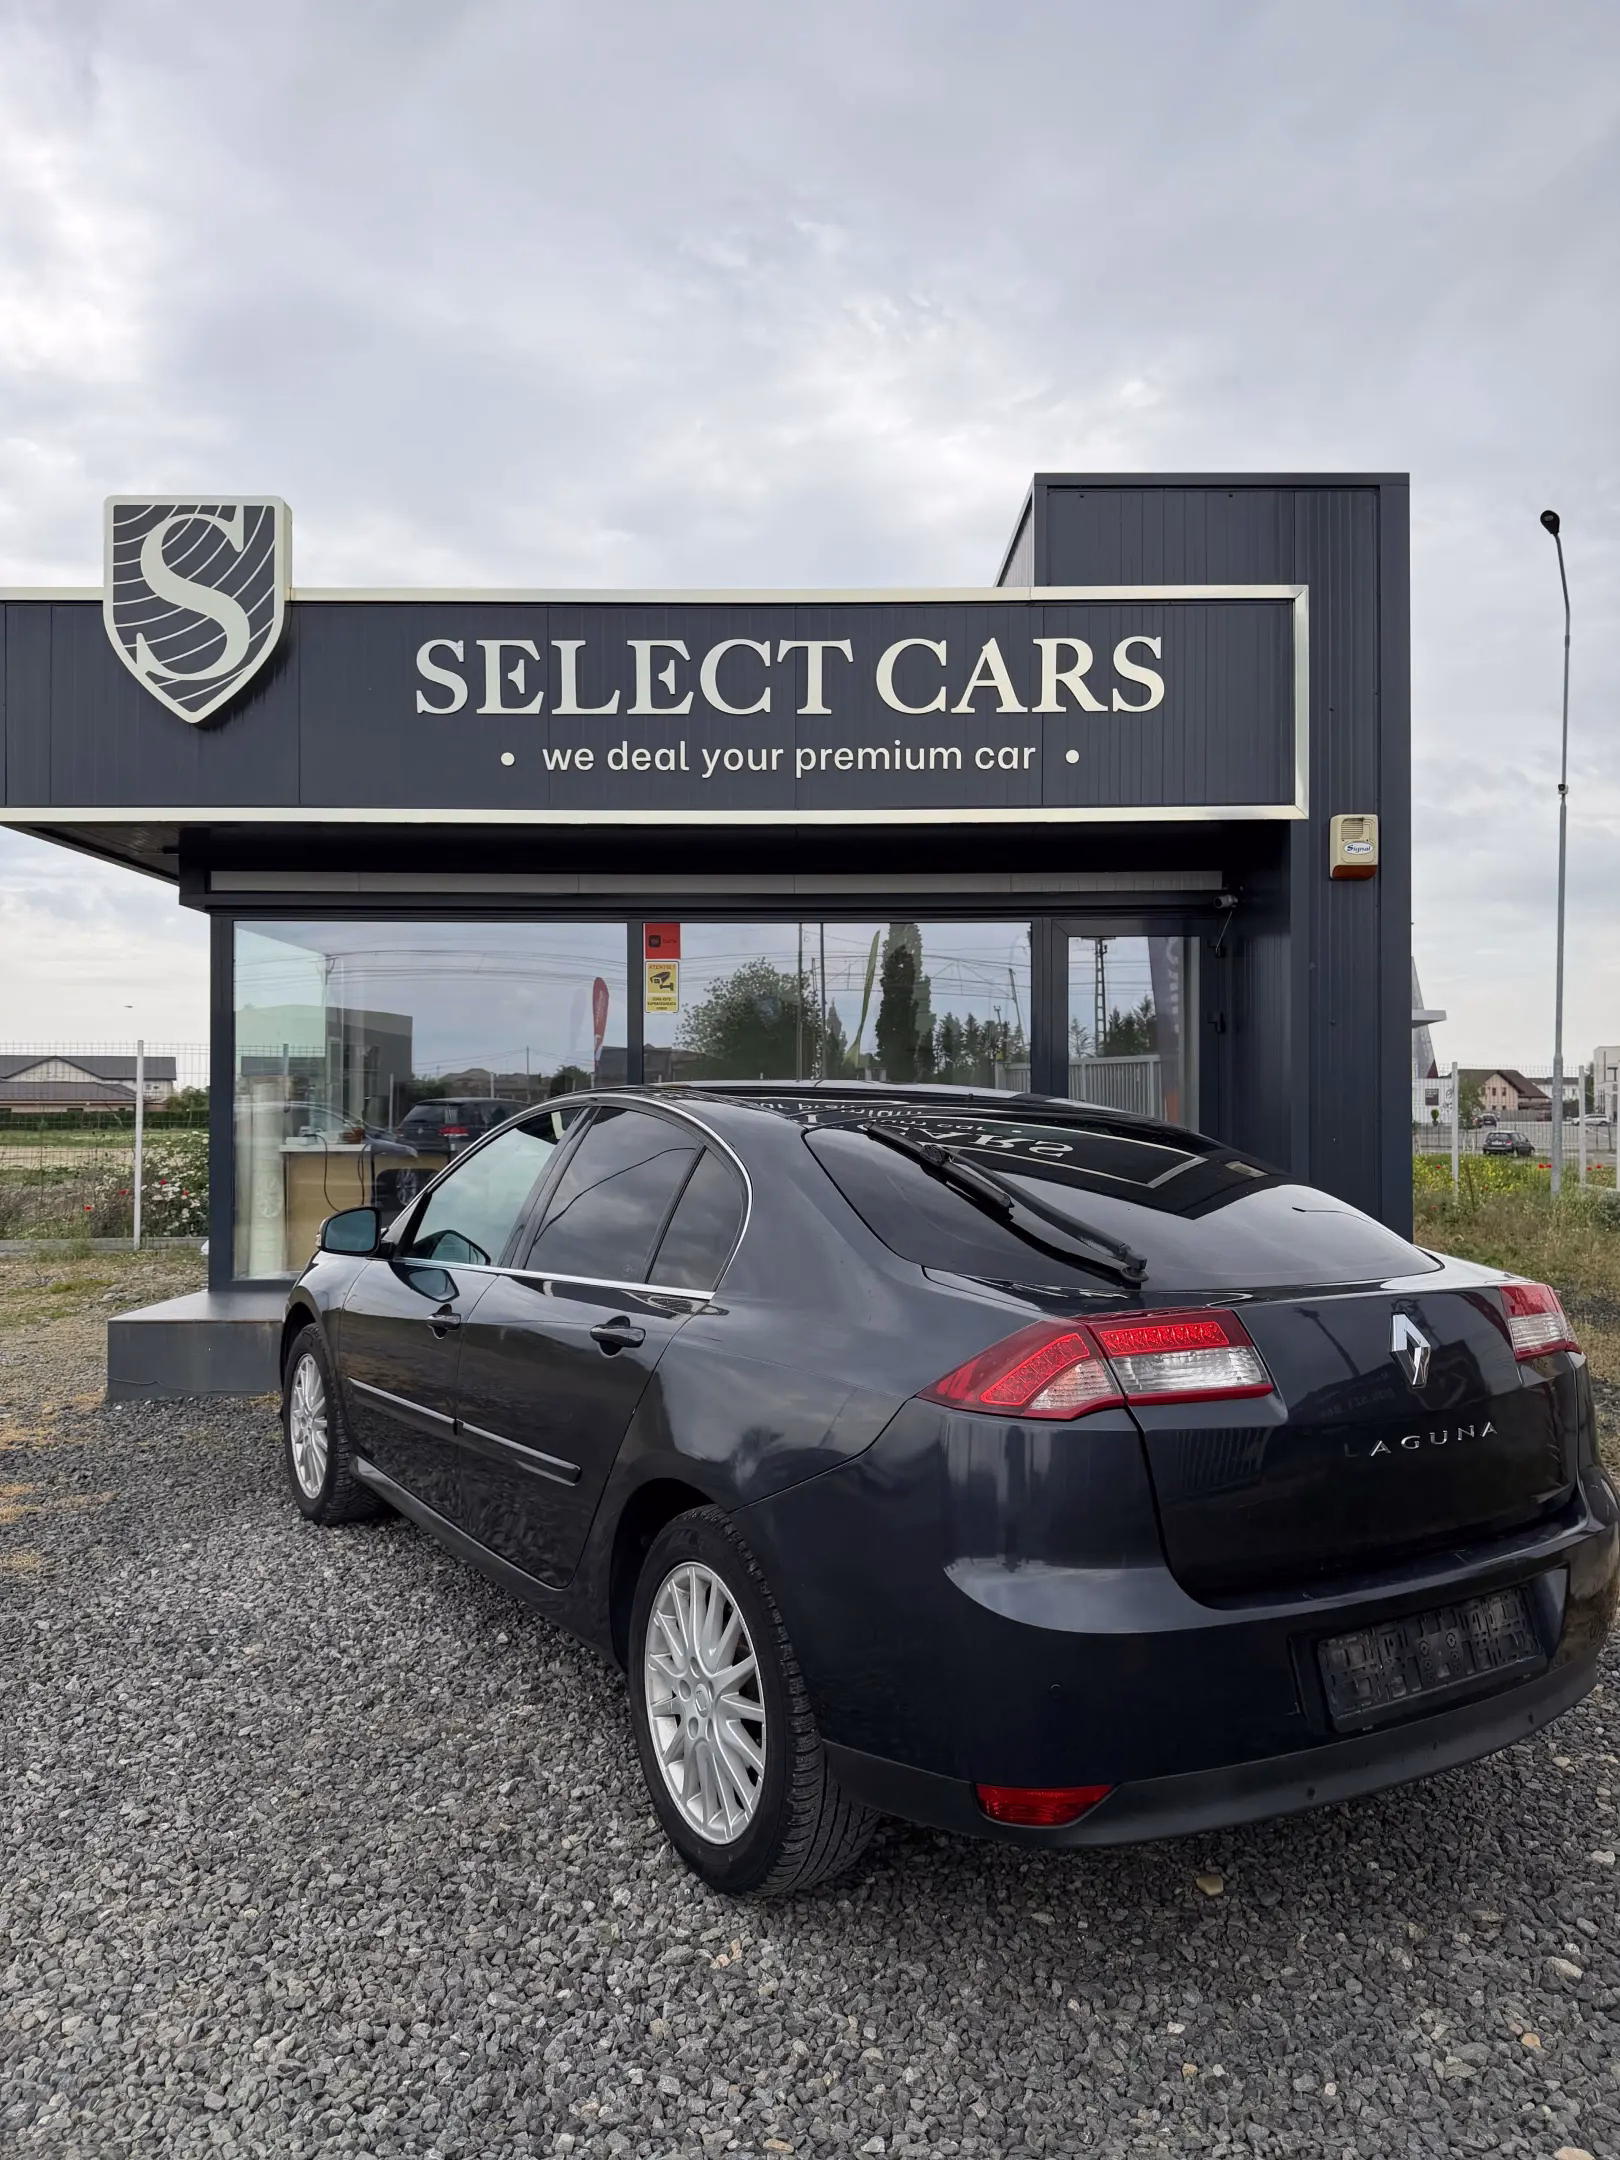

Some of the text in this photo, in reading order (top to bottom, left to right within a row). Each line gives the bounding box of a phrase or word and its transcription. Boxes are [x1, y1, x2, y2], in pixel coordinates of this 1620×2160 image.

[135, 512, 251, 681] S
[415, 636, 1166, 716] SELECT CARS
[542, 739, 1036, 779] we deal your premium car
[1343, 1421, 1499, 1458] LAGUNA
